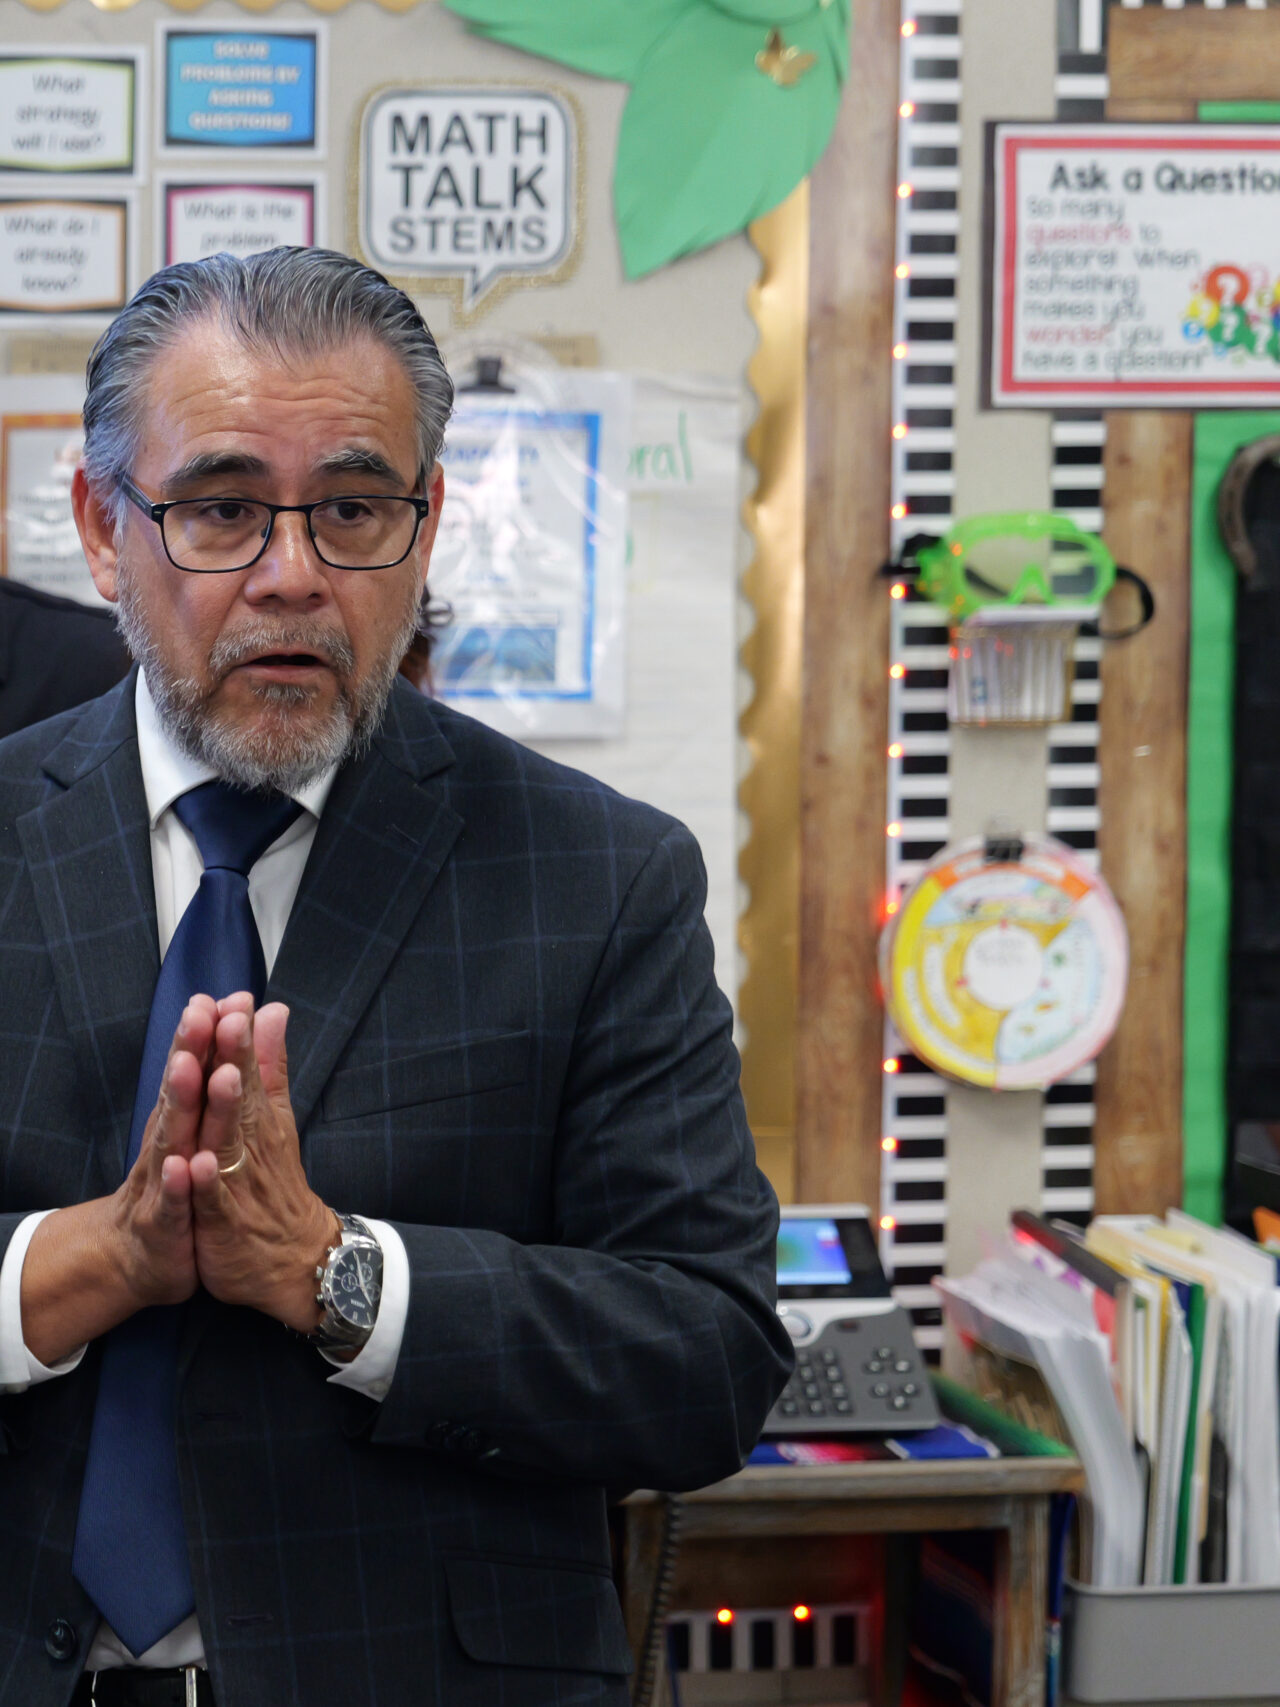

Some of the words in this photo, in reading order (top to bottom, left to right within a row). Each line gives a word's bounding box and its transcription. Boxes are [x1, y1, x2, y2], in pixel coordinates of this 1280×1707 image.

[33, 73, 86, 92] What
[16, 105, 99, 128] strategy
[12, 133, 42, 149] will
[391, 113, 548, 154] MATH
[389, 165, 547, 209] TALK
[1050, 162, 1109, 192] Ask
[1123, 169, 1142, 192] a
[1155, 160, 1280, 194] Questio
[184, 201, 235, 220] What
[264, 202, 293, 219] the
[1027, 198, 1053, 217] So
[1061, 200, 1125, 225] many
[5, 217, 56, 234] What
[63, 217, 84, 234] do
[390, 218, 546, 252] STEMS
[1028, 225, 1131, 249] questions
[1139, 224, 1161, 243] to
[201, 232, 277, 251] problem
[15, 248, 87, 269] already
[1134, 251, 1199, 269] When
[1026, 273, 1138, 299] something
[1024, 299, 1096, 317] makes
[1104, 301, 1145, 328] you
[1121, 328, 1163, 352] you
[1023, 350, 1075, 368] have
